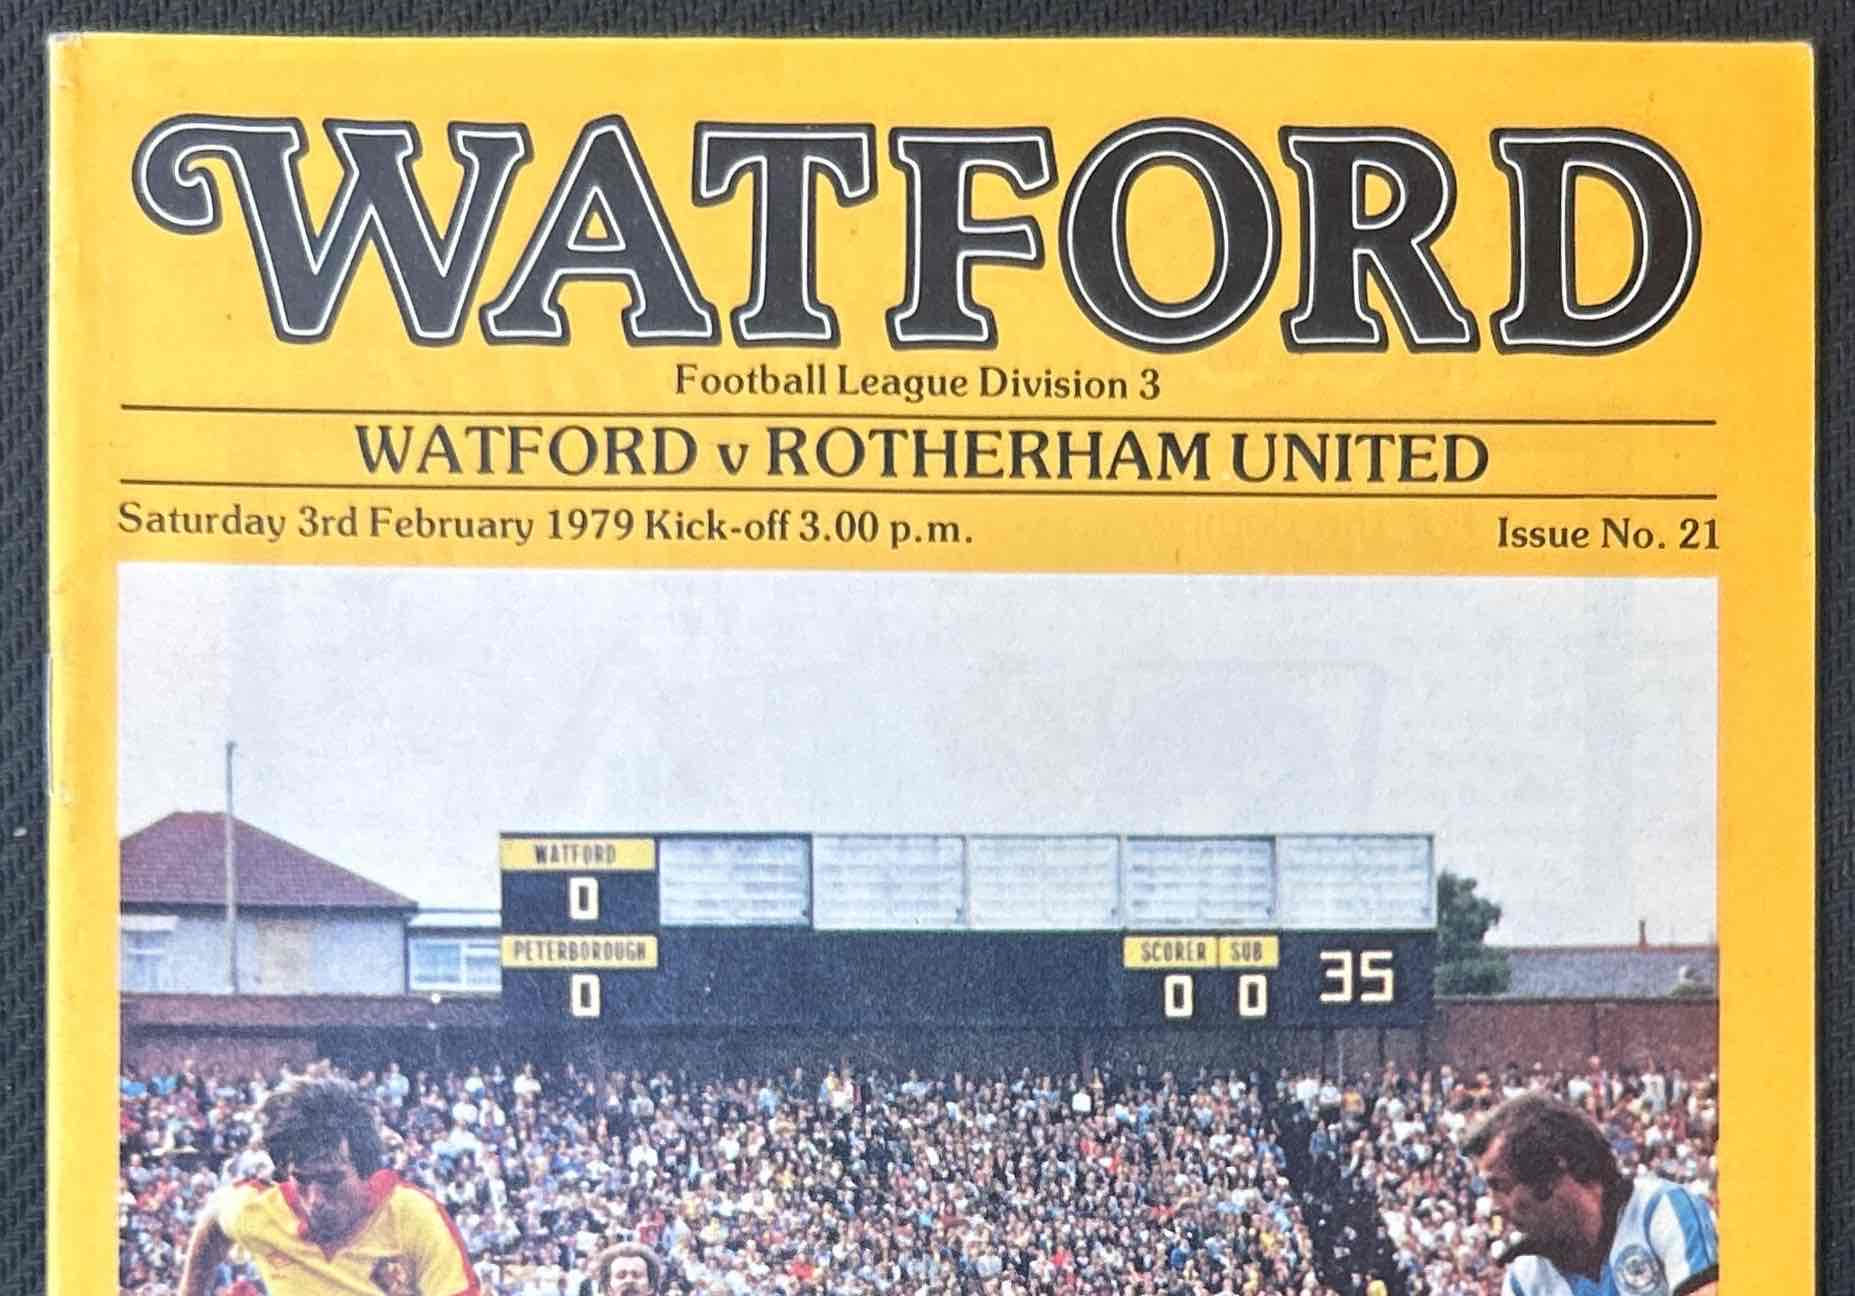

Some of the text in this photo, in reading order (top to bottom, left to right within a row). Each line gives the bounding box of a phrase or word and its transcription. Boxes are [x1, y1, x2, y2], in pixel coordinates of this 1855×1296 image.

[130, 112, 1702, 356] WATFORD
[674, 364, 1162, 403] Football League Division 3
[355, 425, 1490, 484] WATFORD v ROTHERHAM UNITED
[117, 502, 973, 549] Saturday 3rd February 1979 Kick-off 3.00 p.m.
[1497, 516, 1720, 550] Issue No. 21
[533, 843, 618, 866] WATFORD
[568, 876, 600, 921] 0
[513, 940, 648, 962] PETERBOROUGH
[1140, 940, 1264, 964] SCORER SUB
[570, 973, 601, 1018] 0
[1163, 974, 1268, 1018] 0 0
[1319, 949, 1395, 1003] 35
